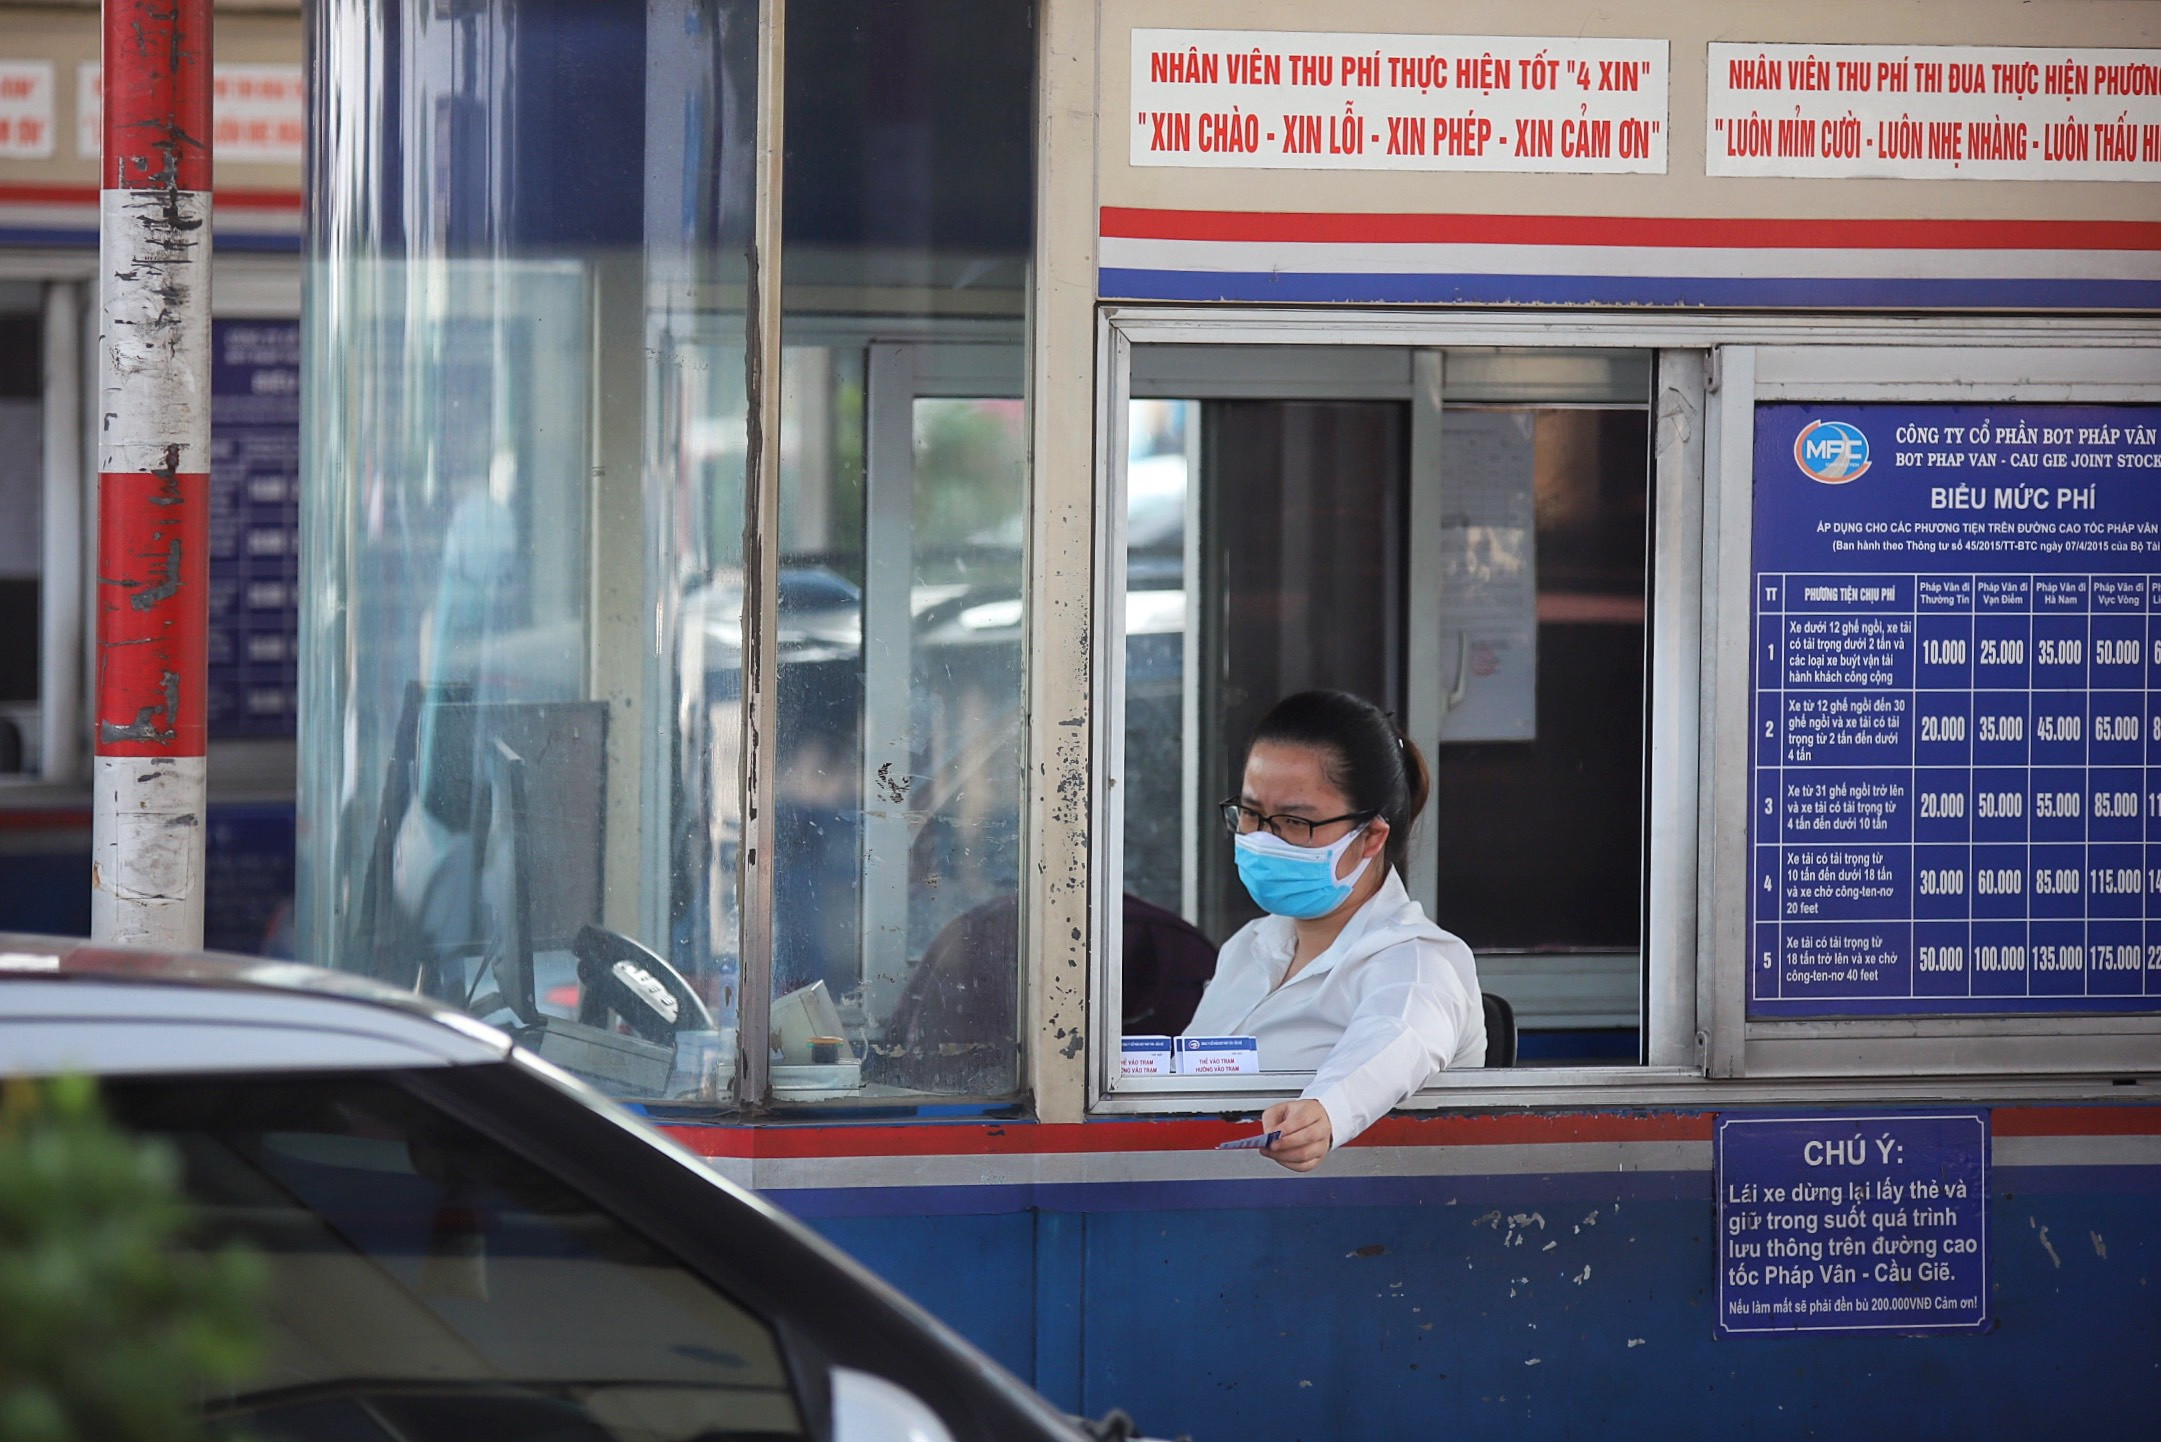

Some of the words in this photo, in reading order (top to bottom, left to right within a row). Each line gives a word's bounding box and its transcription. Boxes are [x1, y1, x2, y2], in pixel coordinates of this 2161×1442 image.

[1152, 46, 1219, 84] NHÂN
[1227, 48, 1281, 85] VIÊN
[1288, 54, 1334, 86] THU
[1341, 50, 1381, 87] PHÍ
[1388, 54, 1448, 95] THỰC
[1456, 52, 1511, 96] HIỆN
[1518, 49, 1561, 91] TỐT
[1729, 54, 1783, 90] NHÂN
[1788, 54, 1832, 91] VIÊN
[1836, 61, 1872, 92] THU
[1877, 56, 1909, 92] PHÍ
[1914, 62, 1943, 93] THI
[1949, 63, 1986, 94] ĐUA
[1992, 61, 2040, 101] THỰC
[2044, 58, 2089, 102] HIỆN
[2094, 64, 2161, 96] PHƯƠN
[1198, 106, 1259, 154] CHÀO
[1283, 115, 1322, 154] XIN
[1330, 100, 1364, 155] LỖI
[1387, 116, 1426, 156] XIN
[1433, 109, 1492, 157] PHÉP
[1515, 118, 1554, 157] XIN
[1561, 103, 1612, 158] CẢM
[1777, 105, 1816, 157] MỈM
[1821, 112, 1862, 159] CƯỜI
[1878, 113, 1924, 160] LUÔN
[1928, 122, 1963, 168] NHẸ
[1968, 115, 2028, 160] NHÀNG
[2044, 115, 2090, 161] LUÔN
[2094, 111, 2138, 162] THẤU
[2142, 124, 2161, 162] HI
[1896, 423, 1939, 443] CÔNG
[1944, 428, 1965, 443] TY
[1970, 419, 1990, 443] CỔ
[1996, 420, 2038, 444] PHẦN
[2043, 429, 2074, 444] BOT
[2079, 424, 2120, 444] PHÁP
[2125, 425, 2156, 444] VÂN
[1896, 453, 1923, 466] BOT
[1928, 453, 1964, 466] PHAP
[1968, 453, 1997, 466] VAN
[2011, 453, 2038, 467] CAU
[2043, 454, 2067, 467] GIE
[2071, 454, 2113, 467] JOINT
[1932, 483, 1985, 509] BIỂU
[1995, 483, 2049, 509] MỨC
[2058, 484, 2095, 509] PHÍ
[1817, 521, 1831, 532] ÁP
[1834, 523, 1862, 534] DỤNG
[1866, 523, 1887, 532] CHO
[1890, 521, 1911, 532] CÁC
[1915, 523, 1960, 533] PHƯƠNG
[1963, 523, 1985, 535] TIỆN
[1988, 521, 2014, 533] TRÊN
[2017, 522, 2056, 533] ĐƯỜNG
[2059, 524, 2081, 533] CAO
[2107, 522, 2134, 533] PHÁP
[2137, 522, 2158, 533] VÂN
[1833, 541, 1854, 552] (Ban
[1857, 540, 1880, 550] hành
[1883, 541, 1903, 550] theo
[1906, 541, 1935, 552] Thông
[1939, 542, 1949, 550] tư
[1952, 539, 1963, 550] số
[1965, 541, 2037, 550] 45/2015/TT-BTC
[2041, 541, 2063, 553] ngày
[2066, 541, 2108, 550] 07/4/2015
[2111, 541, 2127, 550] của
[2131, 541, 2143, 553] Bộ
[2146, 542, 2160, 551] Tài
[1766, 588, 1777, 601] TT
[1768, 644, 1773, 660] 1
[1923, 640, 1965, 664] 10.000
[1981, 640, 2023, 664] 25.000
[2039, 640, 2081, 664] 35.000
[2097, 640, 2139, 664] 50.000
[1766, 721, 1773, 737] 2
[1922, 716, 1965, 741] 20.000
[1980, 716, 2022, 741] 35.000
[2038, 716, 2080, 741] 45.000
[2096, 716, 2138, 740] 65.000
[1765, 798, 1772, 814] 3
[1921, 793, 1964, 817] 20.000
[1979, 793, 2022, 817] 50.000
[2037, 793, 2080, 817] 55.000
[2095, 793, 2137, 817] 85.000
[1764, 875, 1772, 891] 4
[1920, 870, 1963, 894] 30.000
[1979, 870, 2021, 894] 60.000
[2036, 869, 2079, 893] 85.000
[2091, 869, 2141, 893] 115.000
[1764, 952, 1771, 968] 5
[1920, 947, 1962, 971] 50.000
[1975, 946, 2024, 971] 100.000
[2032, 946, 2082, 970] 135.000
[2090, 946, 2140, 970] 175.000
[1804, 1133, 1865, 1165] CHÚ
[1876, 1133, 1902, 1164] Ý:
[1730, 1184, 1757, 1202] Lái
[1764, 1188, 1785, 1202] xe
[1792, 1183, 1842, 1205] dừng
[1850, 1182, 1870, 1204] lại
[1877, 1178, 1904, 1204] lấy
[1910, 1180, 1939, 1199] thẻ
[1945, 1179, 1966, 1198] và
[1729, 1212, 1761, 1235] giữ
[1767, 1212, 1817, 1233] trong
[1824, 1208, 1866, 1228] suốt
[1872, 1208, 1907, 1231] quá
[1913, 1207, 1956, 1226] trình
[1730, 1240, 1760, 1258] lưu
[1767, 1238, 1822, 1261] thông
[1829, 1237, 1865, 1255] trên
[1872, 1235, 1936, 1260] đường
[1944, 1239, 1977, 1253] cao
[1729, 1263, 1758, 1285] tốc
[1766, 1265, 1813, 1288] Pháp
[1820, 1264, 1855, 1283] Vân
[1875, 1260, 1911, 1282] Cầu
[1919, 1262, 1955, 1281] Giẽ.
[1730, 1299, 1749, 1314] Nếu
[1753, 1301, 1770, 1313] làm
[1774, 1297, 1792, 1313] mất
[1795, 1300, 1806, 1312] sẽ
[1810, 1299, 1831, 1315] phải
[1834, 1296, 1852, 1311] đền
[1856, 1298, 1868, 1311] bù
[1872, 1297, 1931, 1310] 200.000VNĐ
[1935, 1296, 1957, 1309] Cảm
[1960, 1296, 1977, 1308] ơn!
